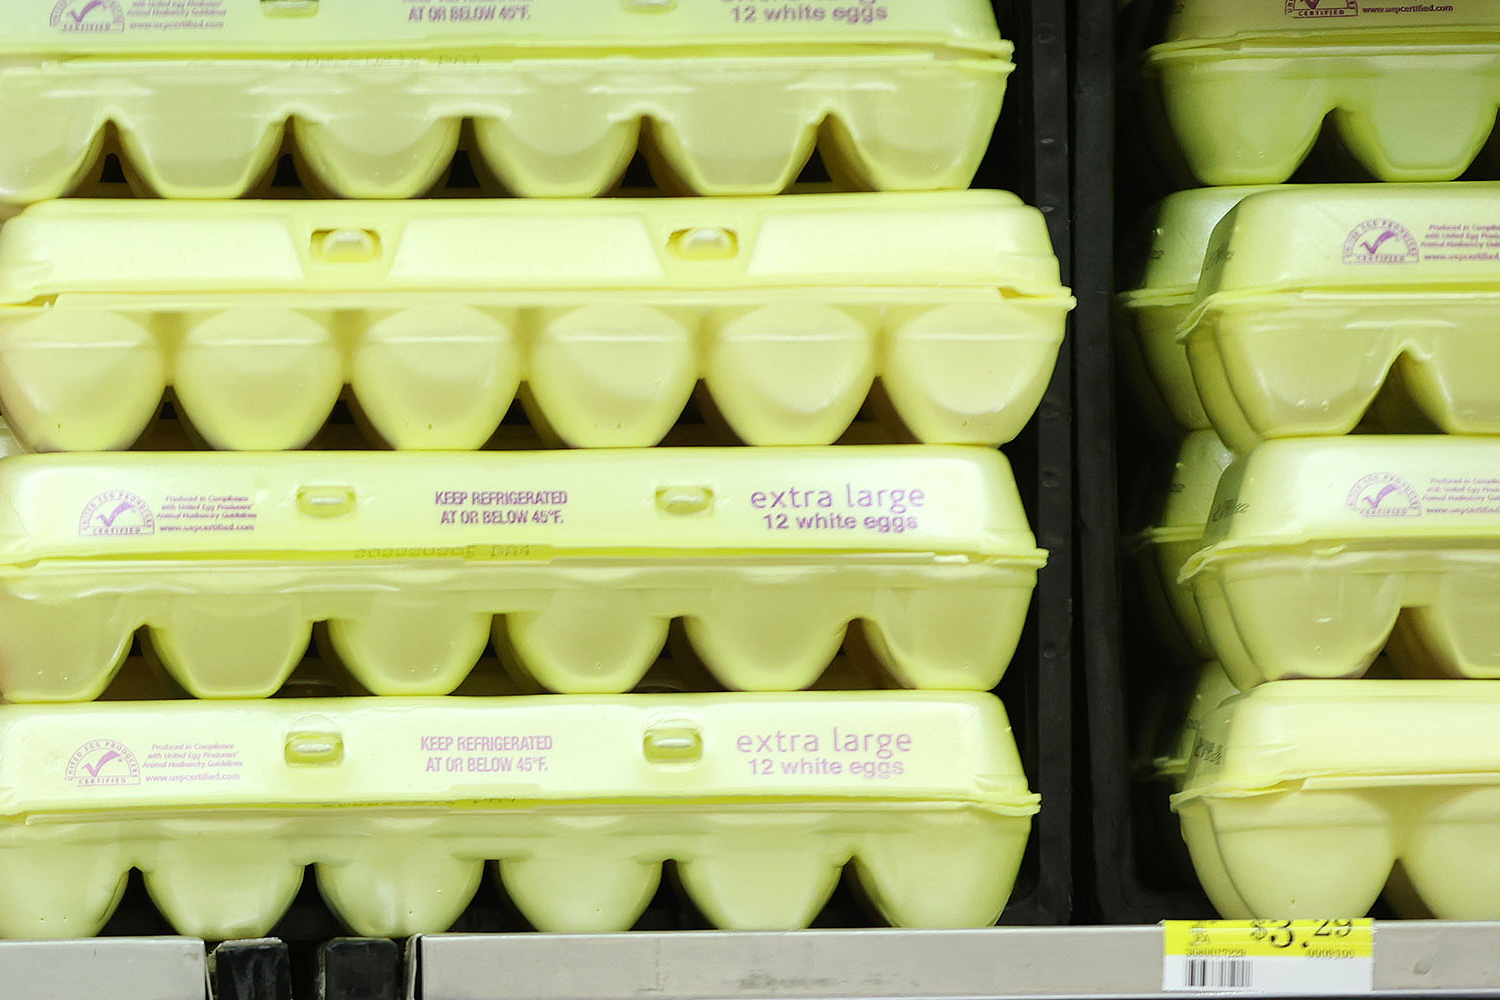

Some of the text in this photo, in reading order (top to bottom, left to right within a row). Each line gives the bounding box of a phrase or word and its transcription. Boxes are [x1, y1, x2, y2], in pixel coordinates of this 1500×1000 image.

[732, 4, 888, 24] 12 white eggs
[436, 491, 567, 505] KEEP REFRIGERATED
[751, 483, 924, 514] extra large
[441, 510, 563, 524] AT OR BELOW 45°F.
[764, 513, 917, 533] 12 white eggs
[421, 736, 553, 752] KEEP REFRIGERATED
[737, 727, 912, 758] extra large
[426, 756, 548, 772] AT OR BELOW 45°F.
[748, 757, 904, 779] 12 white eggs
